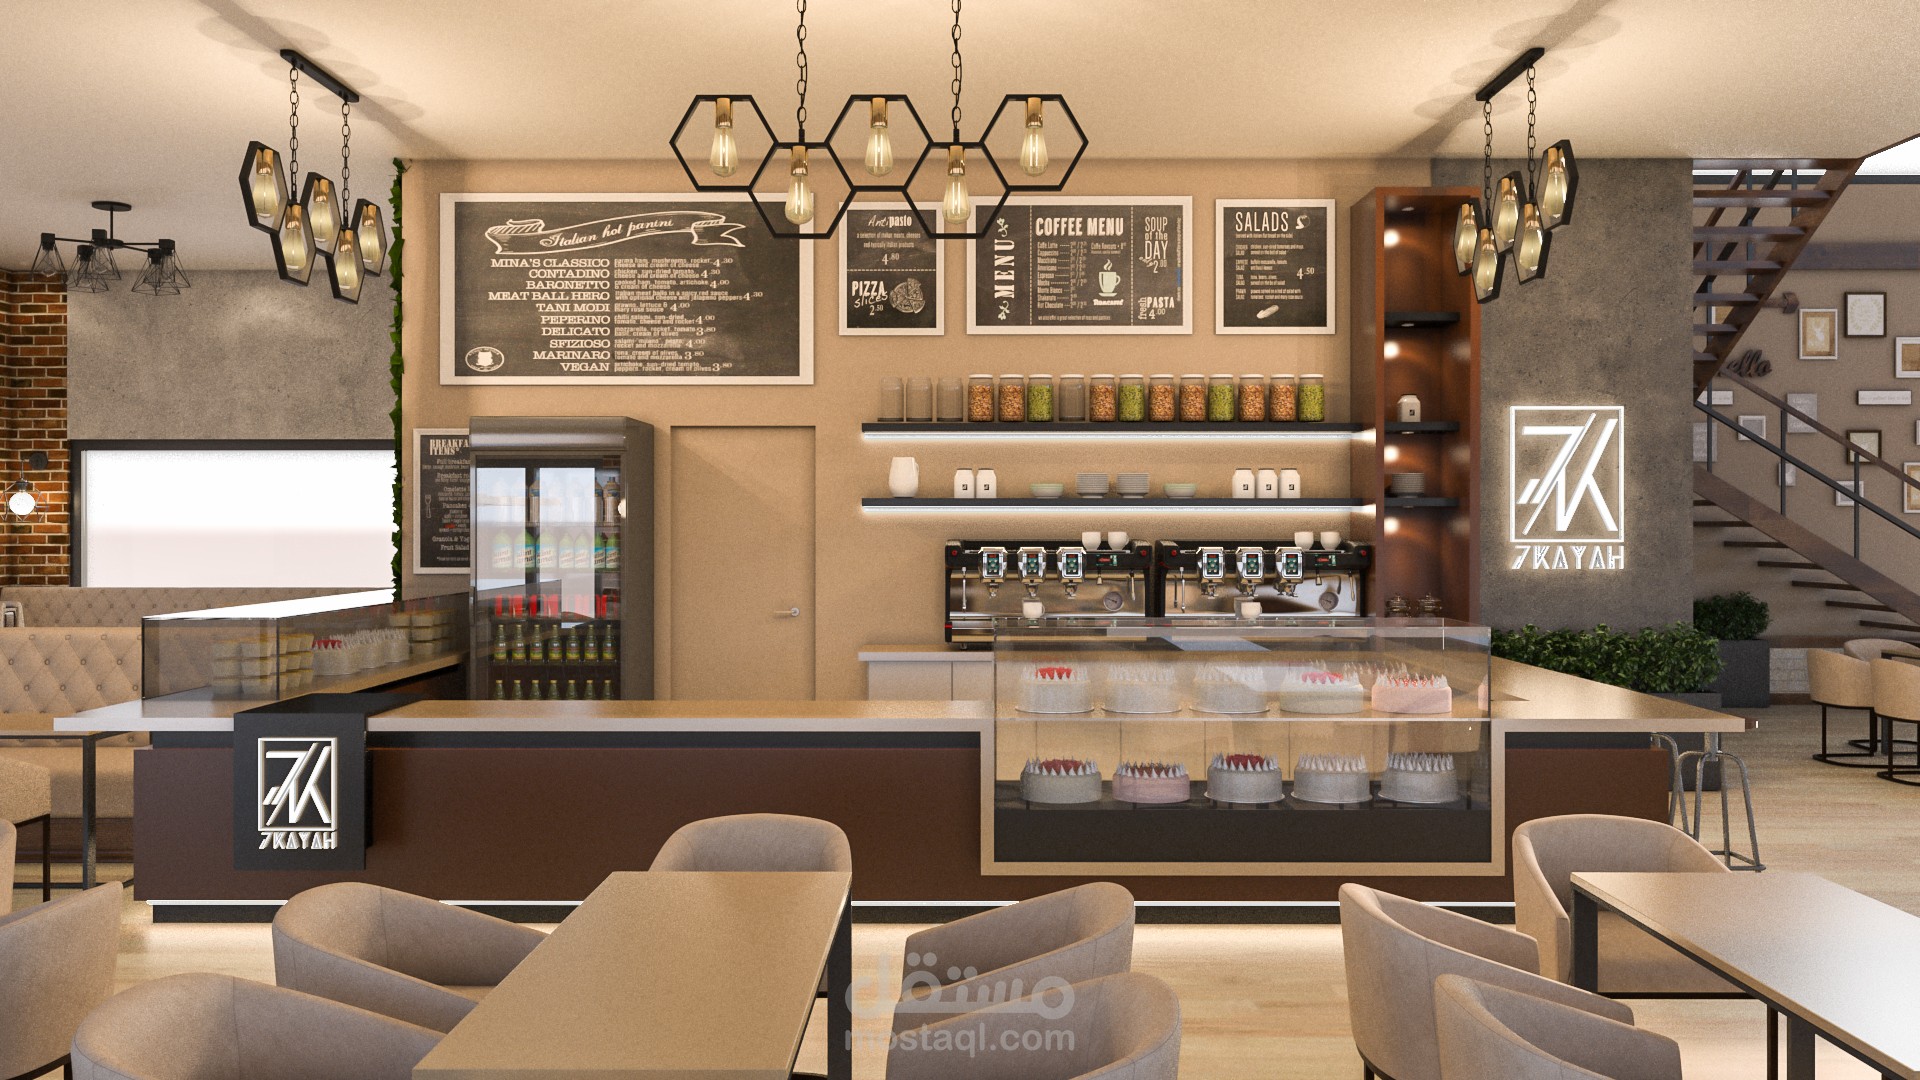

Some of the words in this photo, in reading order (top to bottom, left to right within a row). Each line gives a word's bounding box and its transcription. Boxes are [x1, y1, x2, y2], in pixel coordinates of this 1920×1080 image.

[1035, 217, 1083, 236] COFFEE
[1087, 217, 1124, 236] MENU
[1144, 216, 1168, 232] SOUP
[1235, 211, 1289, 232] SALADS
[539, 230, 598, 248] Italian
[602, 223, 623, 238] hot
[626, 219, 674, 237] panini
[1144, 231, 1153, 240] of
[1155, 231, 1168, 240] the
[1144, 240, 1169, 260] DAY
[490, 258, 541, 268] MINA'S
[543, 258, 610, 268] CLASSICO
[994, 238, 1015, 299] MENU
[528, 268, 610, 279] CONTADINO
[1296, 267, 1315, 280] 4.50
[525, 280, 610, 290] BARONETTO
[851, 281, 885, 297] PIZZA
[488, 291, 530, 301] MEAT
[532, 291, 570, 301] BALL
[571, 291, 610, 301] HERO
[853, 289, 888, 309] slices
[1146, 296, 1175, 309] PASTA
[535, 303, 571, 312] TANI
[573, 303, 610, 312] MODI
[1137, 297, 1147, 320] fresh
[540, 315, 610, 325] PEPERINO
[541, 327, 610, 336] DELICATO
[549, 339, 610, 349] SFIZIOSO
[532, 350, 610, 360] MARINARO
[559, 362, 610, 372] VEGAN
[429, 438, 470, 448] BREAKFA
[1511, 545, 1625, 570] 7KAYAH
[258, 831, 338, 850] 7KAYAH
